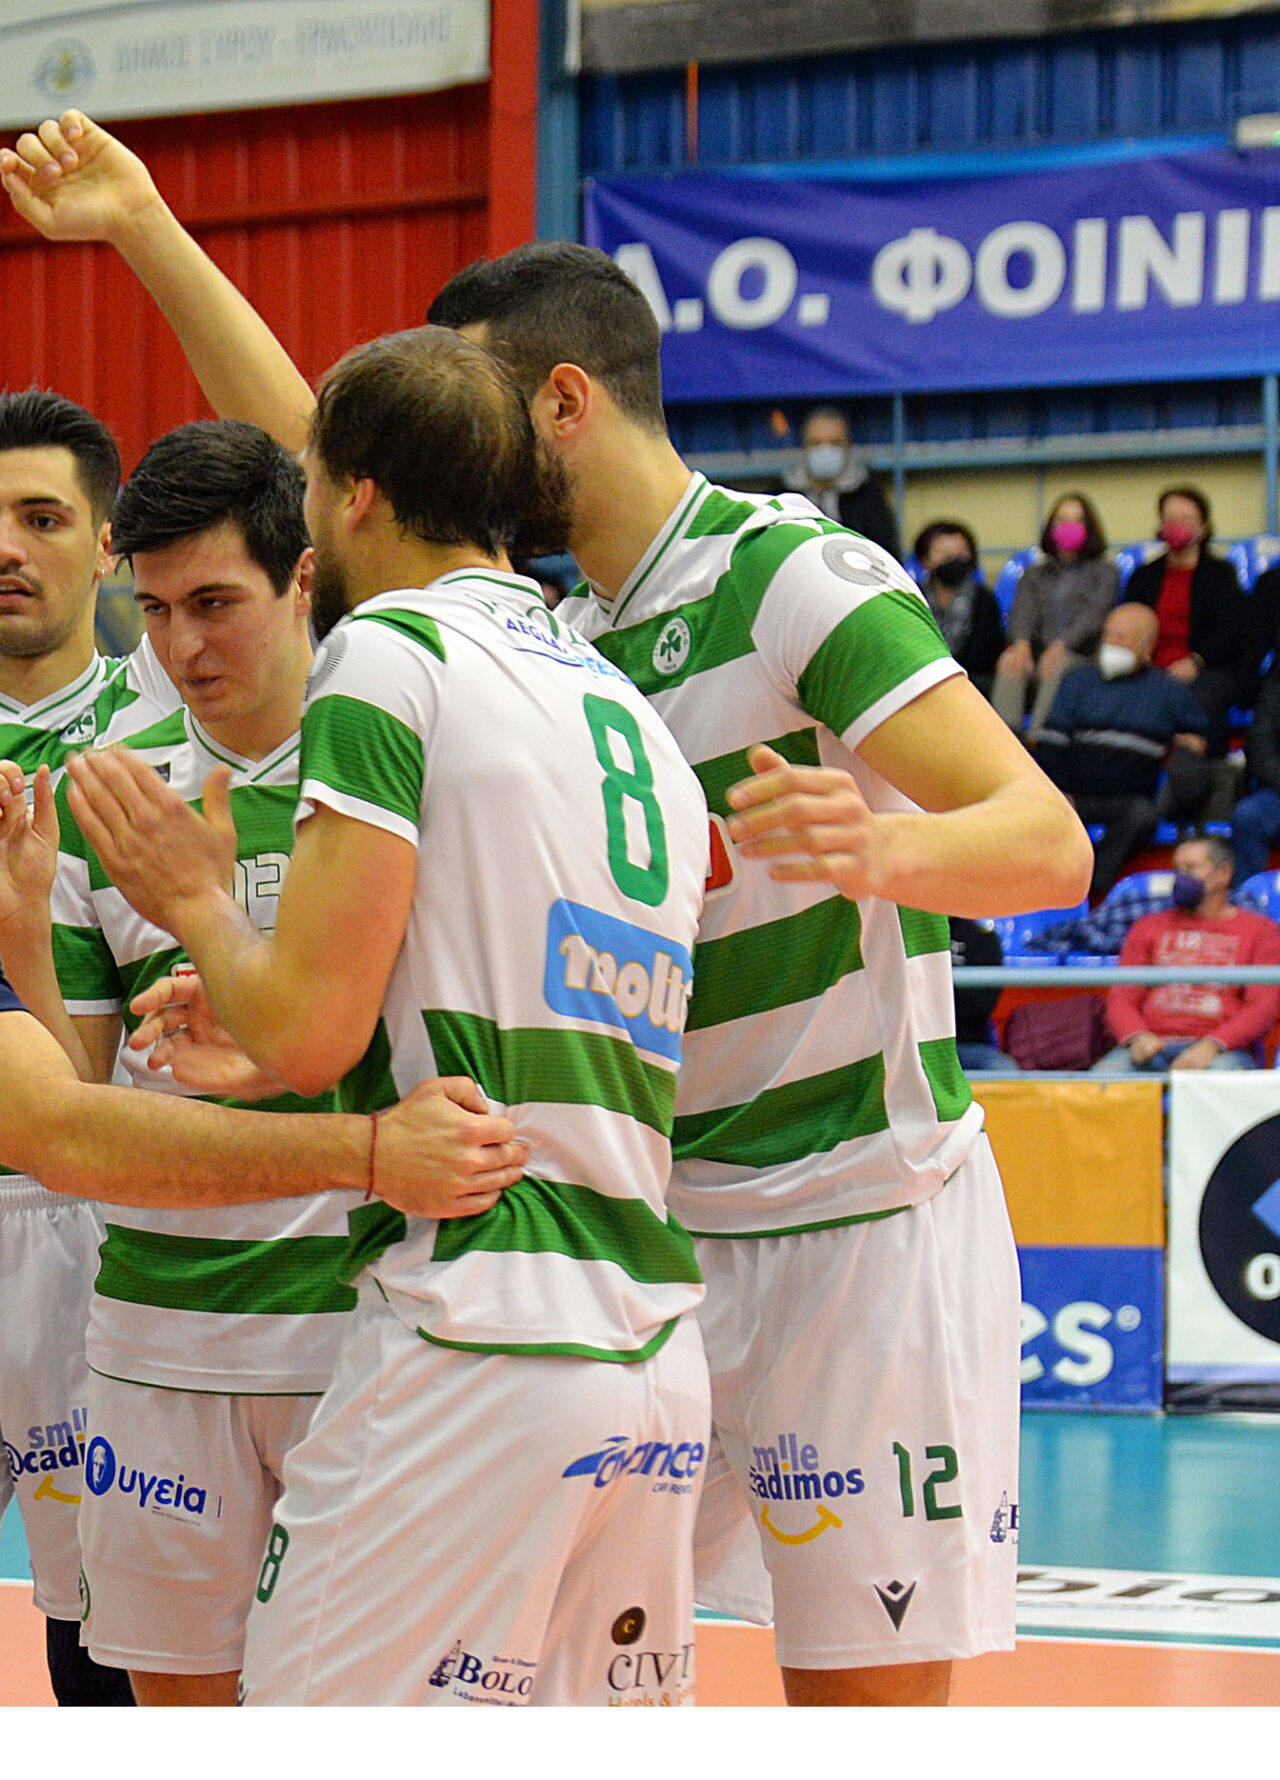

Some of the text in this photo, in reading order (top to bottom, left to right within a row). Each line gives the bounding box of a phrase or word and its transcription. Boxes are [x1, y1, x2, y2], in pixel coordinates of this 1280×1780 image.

[583, 692, 670, 908] 8
[559, 932, 693, 1033] molt
[892, 1441, 964, 1521] 12
[256, 1523, 289, 1604] 8
